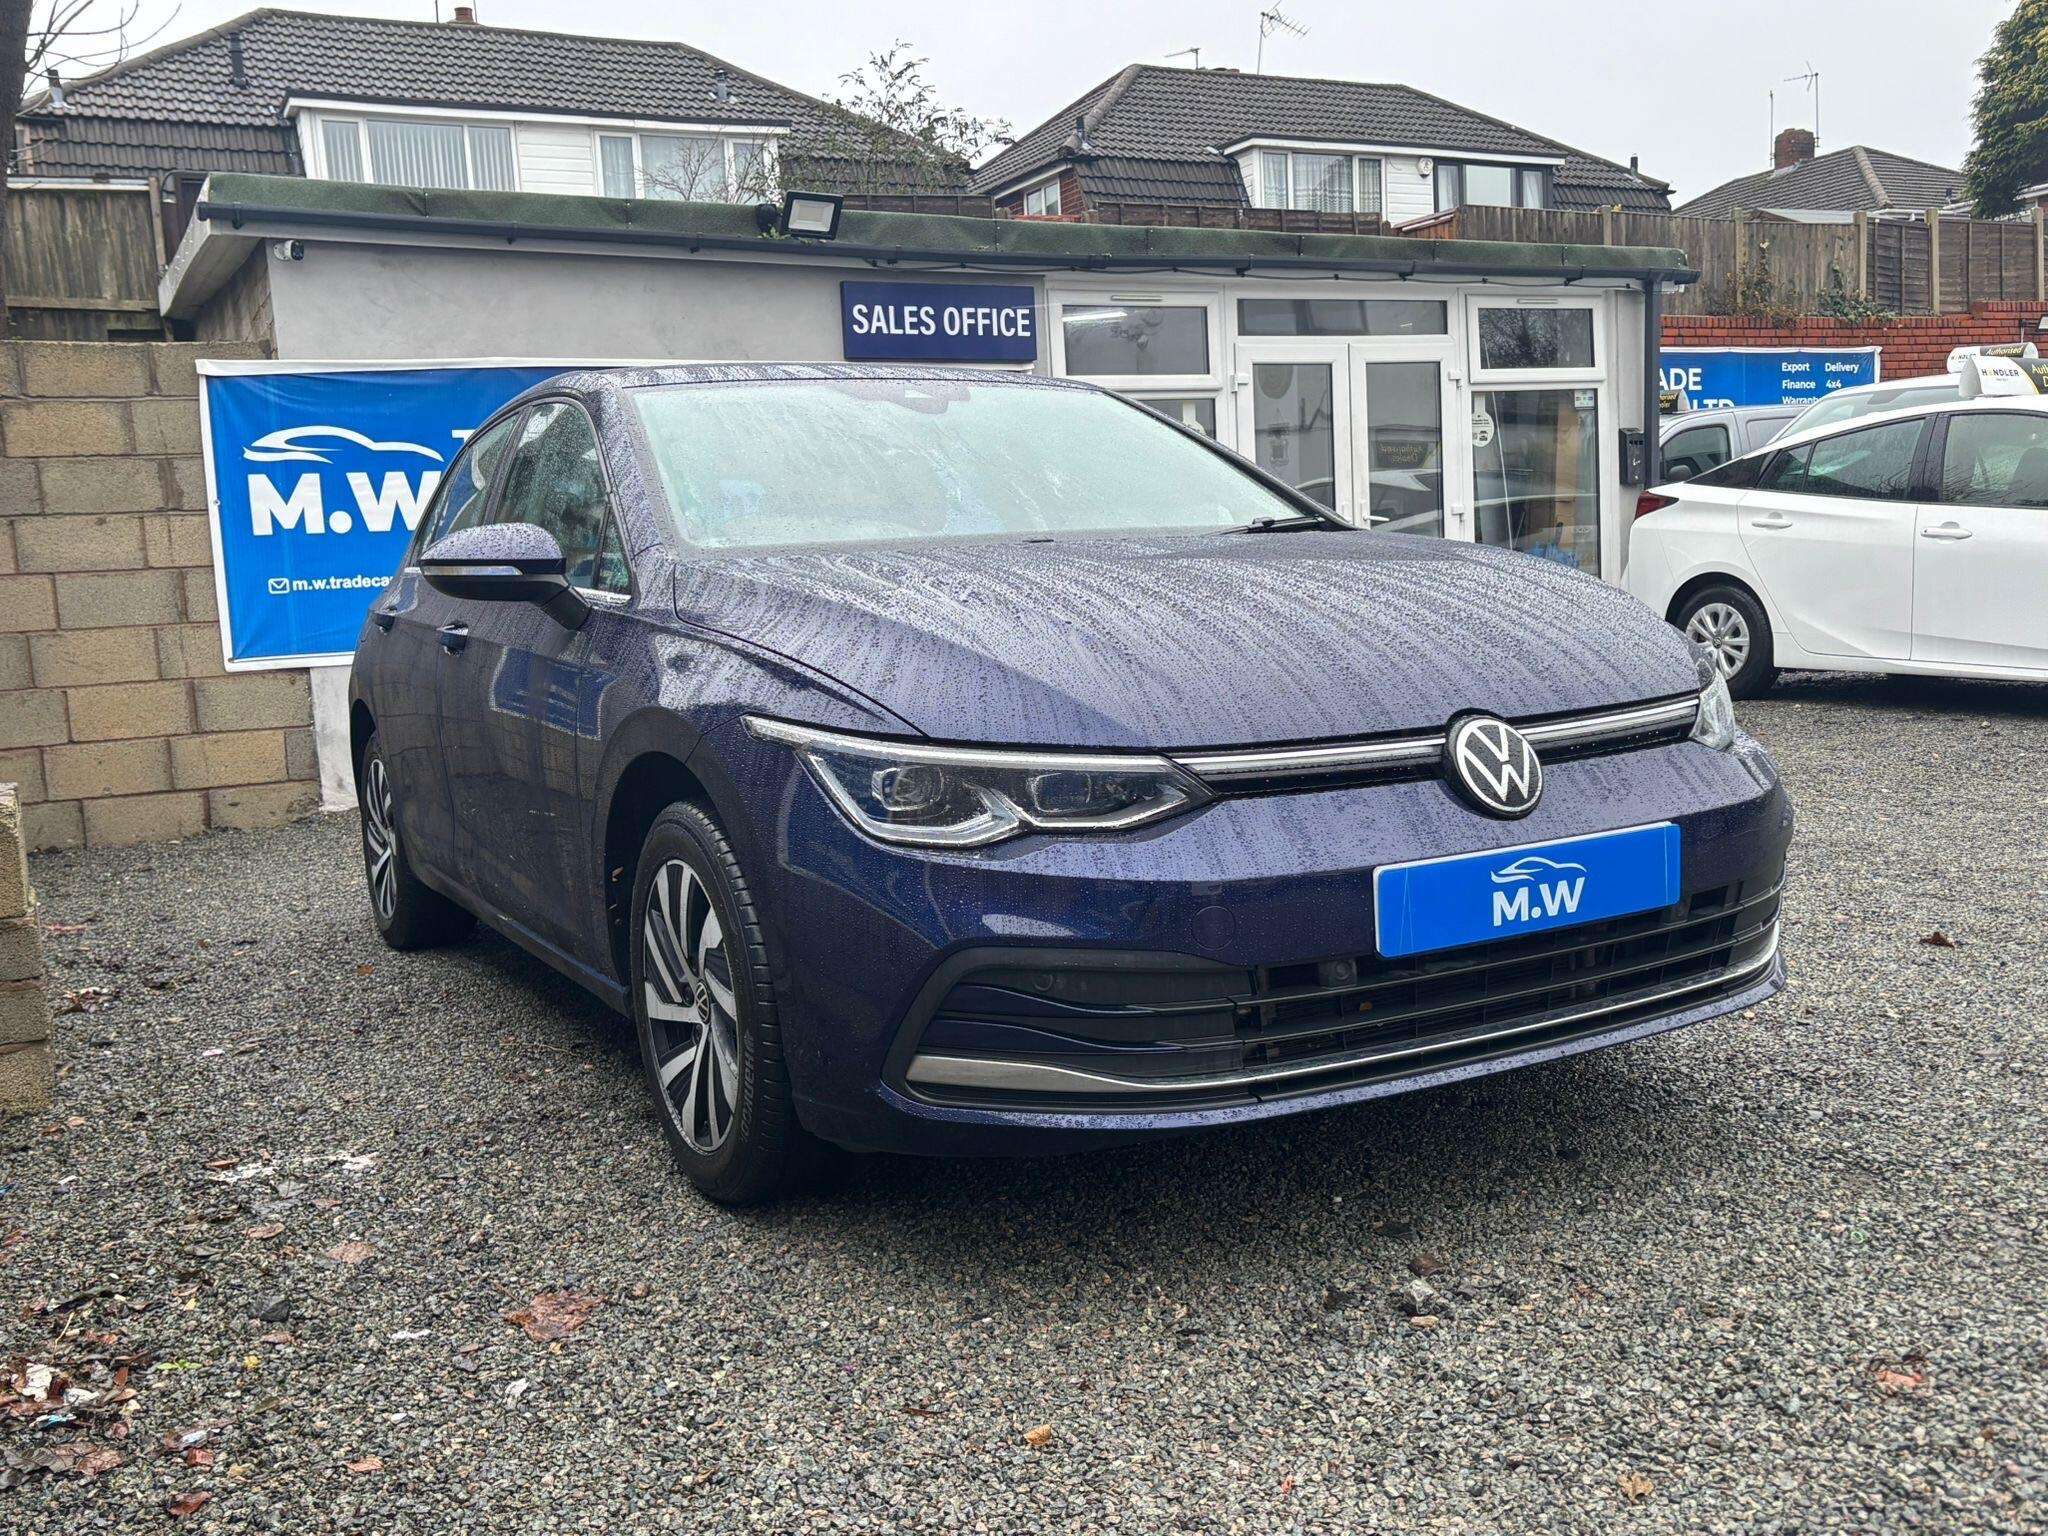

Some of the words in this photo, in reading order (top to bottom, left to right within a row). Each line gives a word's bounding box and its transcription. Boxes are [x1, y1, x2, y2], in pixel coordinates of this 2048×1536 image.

[852, 304, 936, 335] SALES
[943, 306, 1031, 337] OFFICE
[1781, 362, 1810, 374] Export
[1825, 362, 1860, 374] Delivery
[1782, 379, 1816, 389] Finance
[1825, 380, 1842, 389] 4x4
[247, 470, 442, 536] M.W
[1492, 877, 1585, 927] M.W
